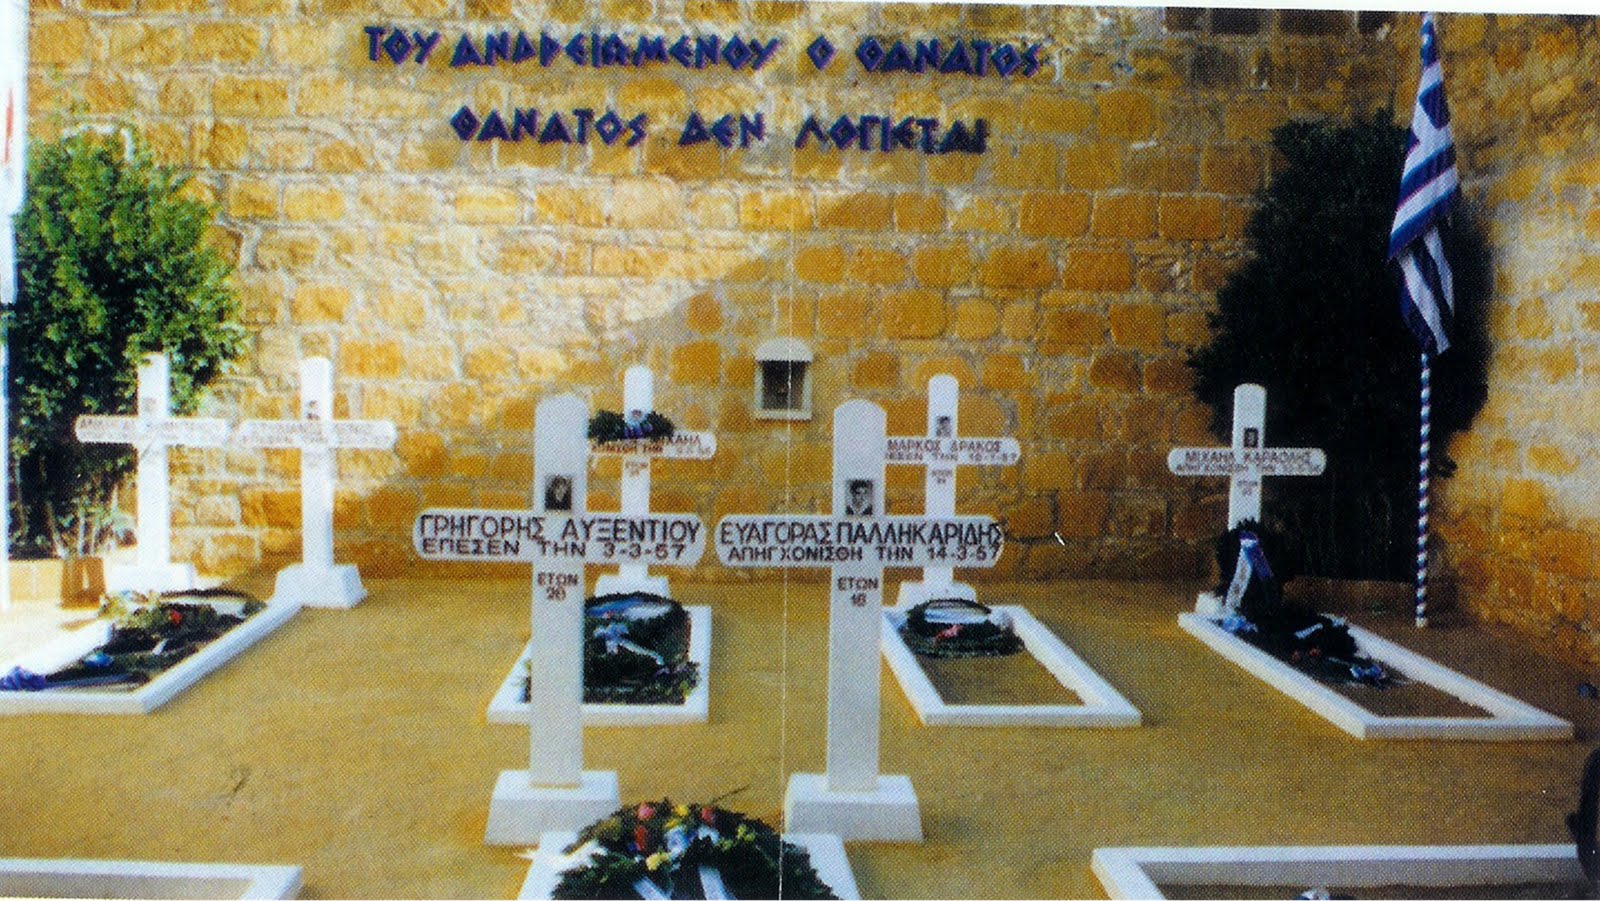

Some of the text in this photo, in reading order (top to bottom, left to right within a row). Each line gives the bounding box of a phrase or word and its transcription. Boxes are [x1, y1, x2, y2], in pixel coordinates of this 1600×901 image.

[364, 25, 1043, 77] ΤΟΥ ΑΝΔΡΕΙΩΜΕΝΟΥ Ο ΘΑΝΑΤΟΣ
[450, 106, 990, 154] ΘΑΝΑΤΟΣ ΔΕΝ ΛΟΓΙΕΤΑΙ
[419, 514, 702, 543] ΓΡΗΓΟΡΗΣ ΑΥΞΕΝΤΙΟΥ
[720, 521, 1004, 546] ΕΥΑΓΟΡΑΣ ΠΑΛΛΗΚΑΡΙΔΗΣ
[422, 538, 687, 560] ΕΠΕΣΕΝ ΤΗΝ 3-3-57
[728, 545, 999, 562] ΑΠΗΓΧΟΝΙΣΘΗ ΤΗΝ 14-3-57
[837, 577, 879, 591] ΕΤΩΝ
